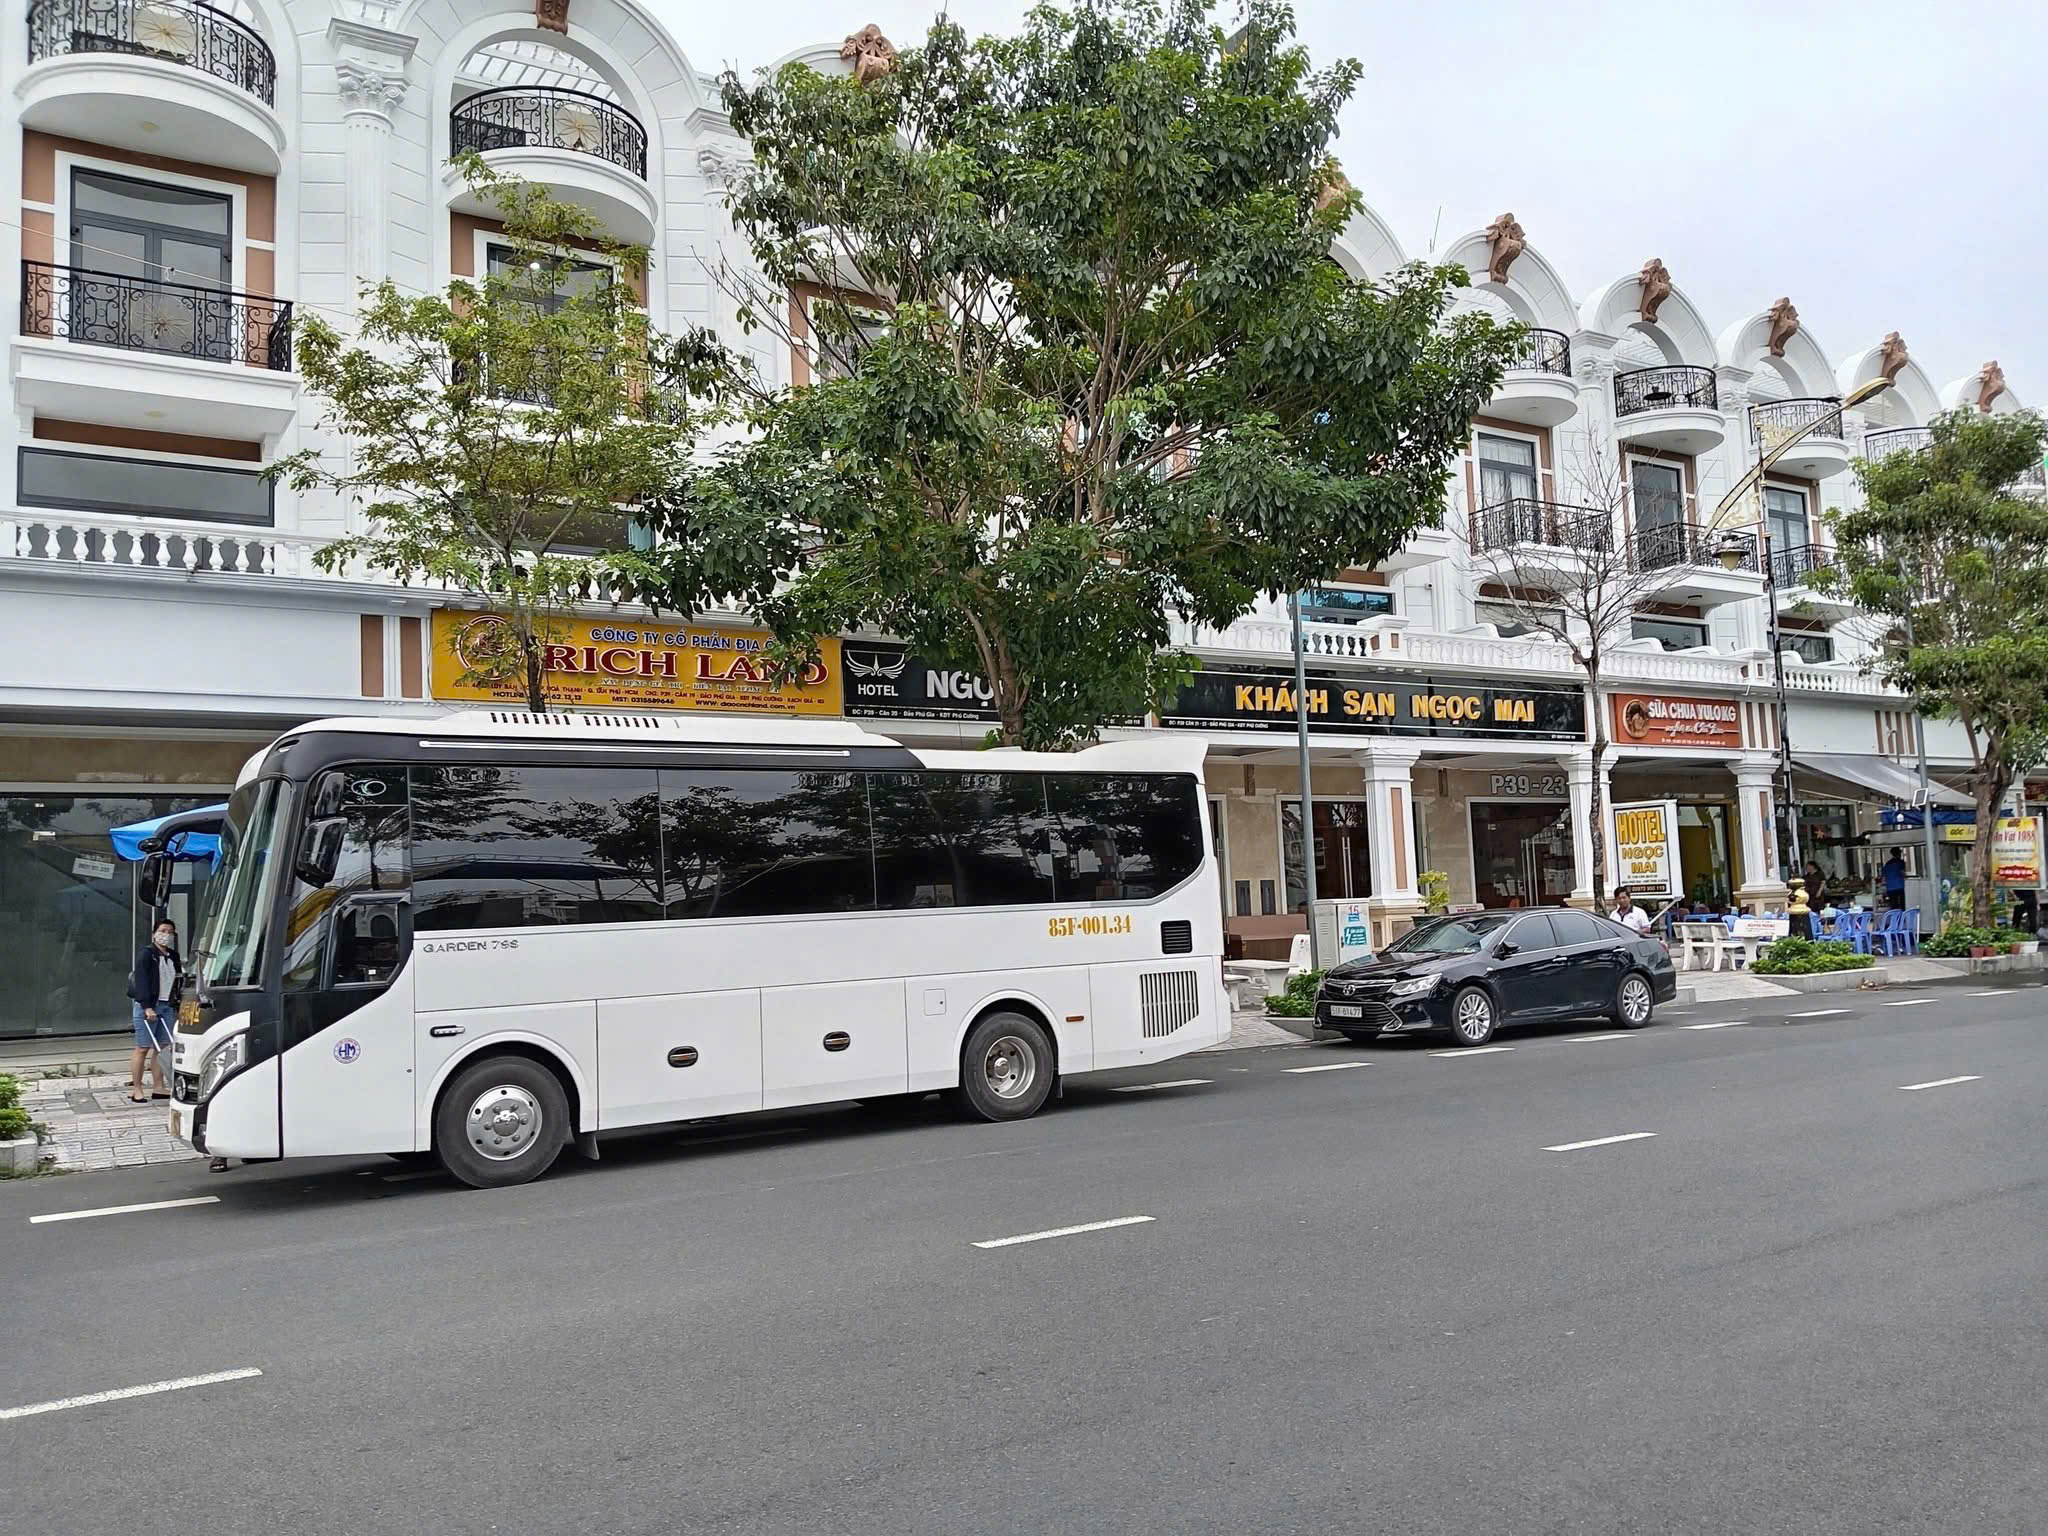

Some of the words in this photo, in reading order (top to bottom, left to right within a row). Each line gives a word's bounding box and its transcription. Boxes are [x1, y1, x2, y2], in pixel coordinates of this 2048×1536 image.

[589, 625, 638, 642] CÔNG
[642, 630, 660, 645] TY
[664, 627, 687, 646] CỔ
[691, 631, 731, 650] PHẦN
[735, 637, 761, 655] ĐỊA
[544, 643, 679, 678] RICH
[857, 684, 899, 697] HOTEL
[926, 670, 1004, 707] NGỌ
[1234, 680, 1328, 715] KHÁCH
[1343, 689, 1395, 722] SẠN
[1412, 694, 1481, 725] NGỌC
[1494, 699, 1535, 723] MAI
[1648, 698, 1668, 719] SỮA
[1669, 702, 1697, 720] CHUA
[1490, 774, 1567, 795] P39-23
[1616, 810, 1666, 845] HOTEL
[1622, 845, 1664, 860] NGỌC
[1631, 861, 1657, 874] MAI
[1047, 914, 1133, 937] 85F-001.34
[423, 940, 487, 953] GARDEN
